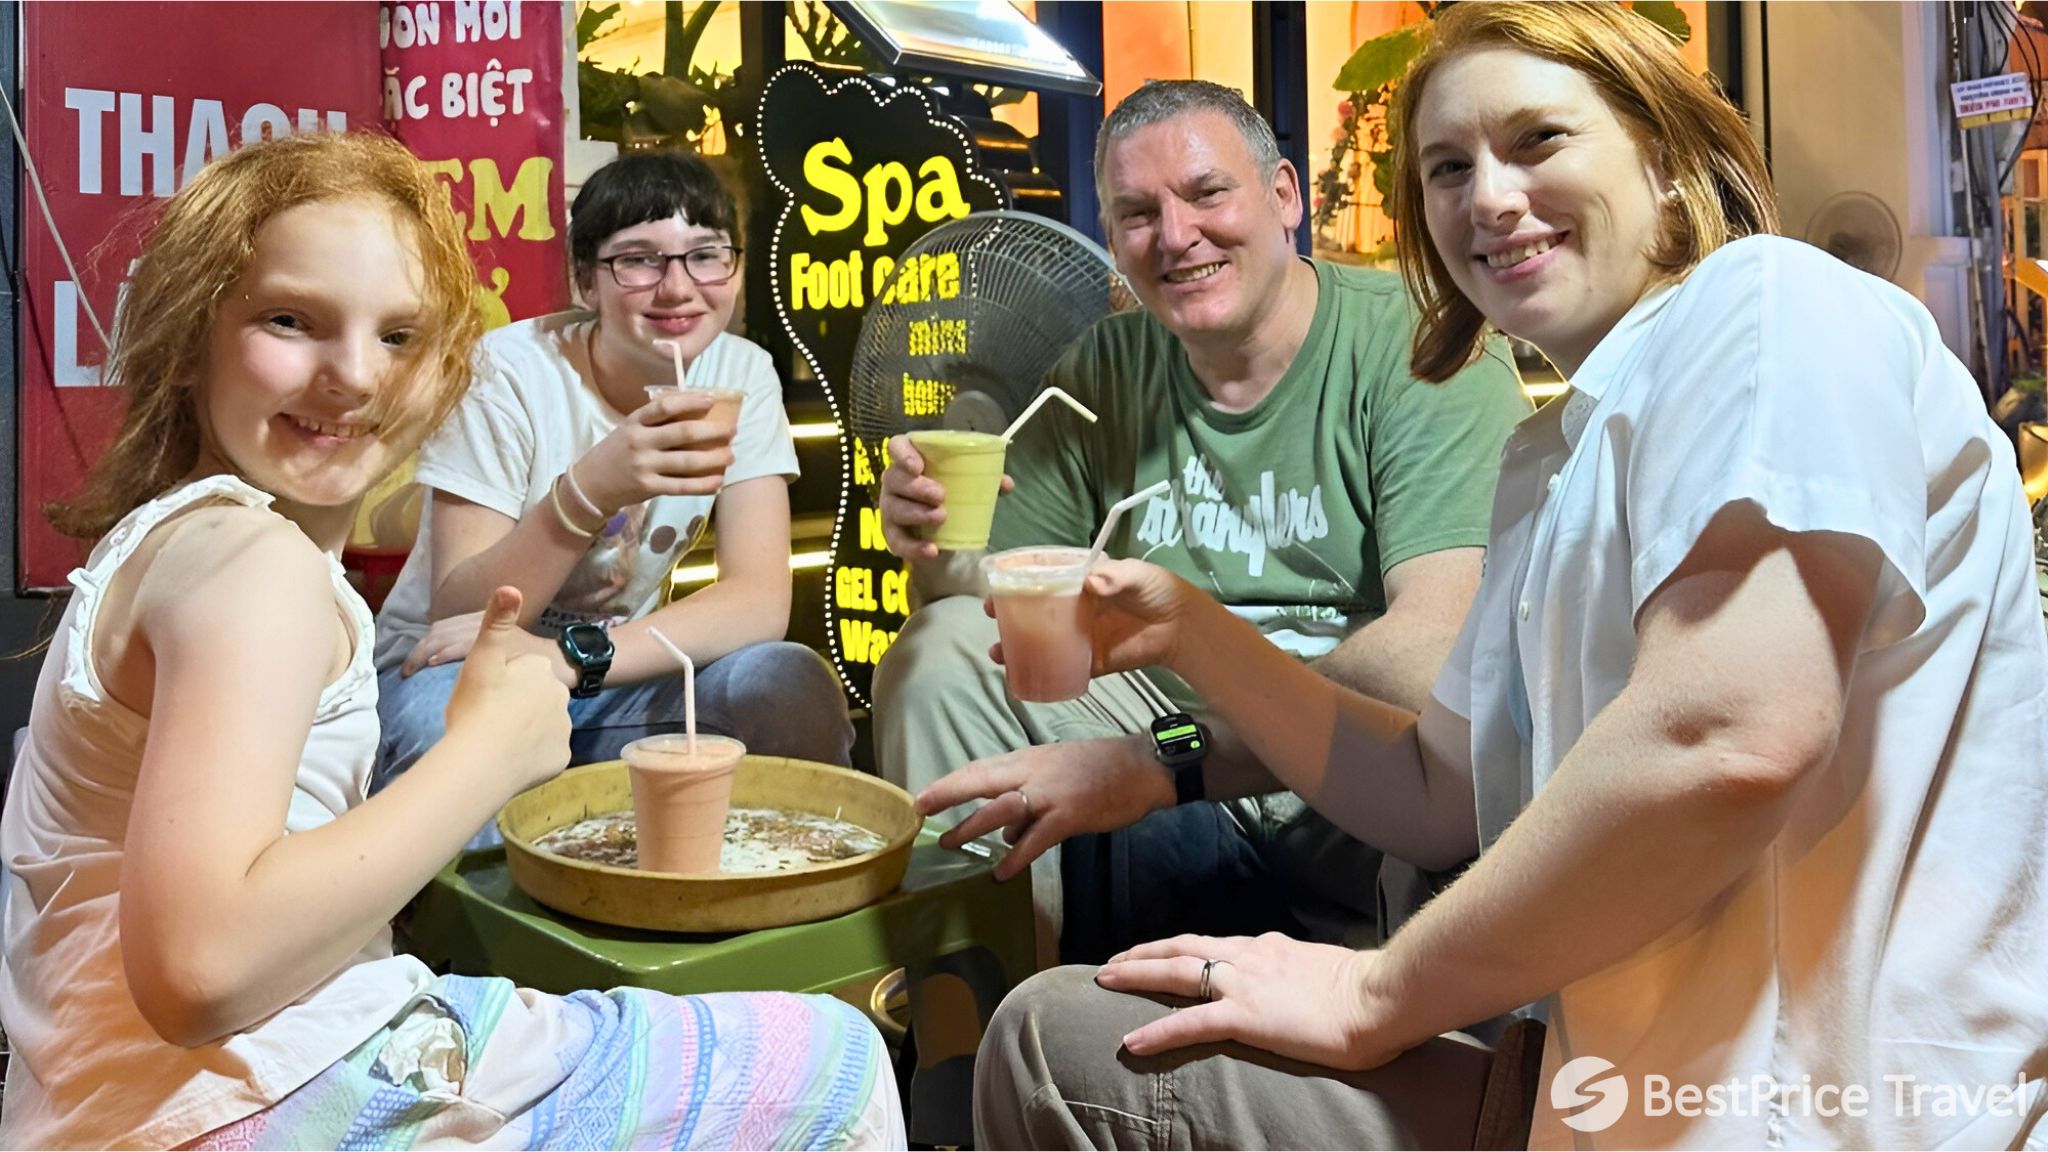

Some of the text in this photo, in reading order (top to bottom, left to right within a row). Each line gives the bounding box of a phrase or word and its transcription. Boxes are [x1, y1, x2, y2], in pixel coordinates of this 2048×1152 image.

[441, 57, 534, 128] BIỆT
[64, 87, 348, 198] THA
[801, 137, 972, 248] Spa
[790, 250, 961, 311] Foot care
[1183, 453, 1225, 501] the
[835, 566, 878, 612] GEL
